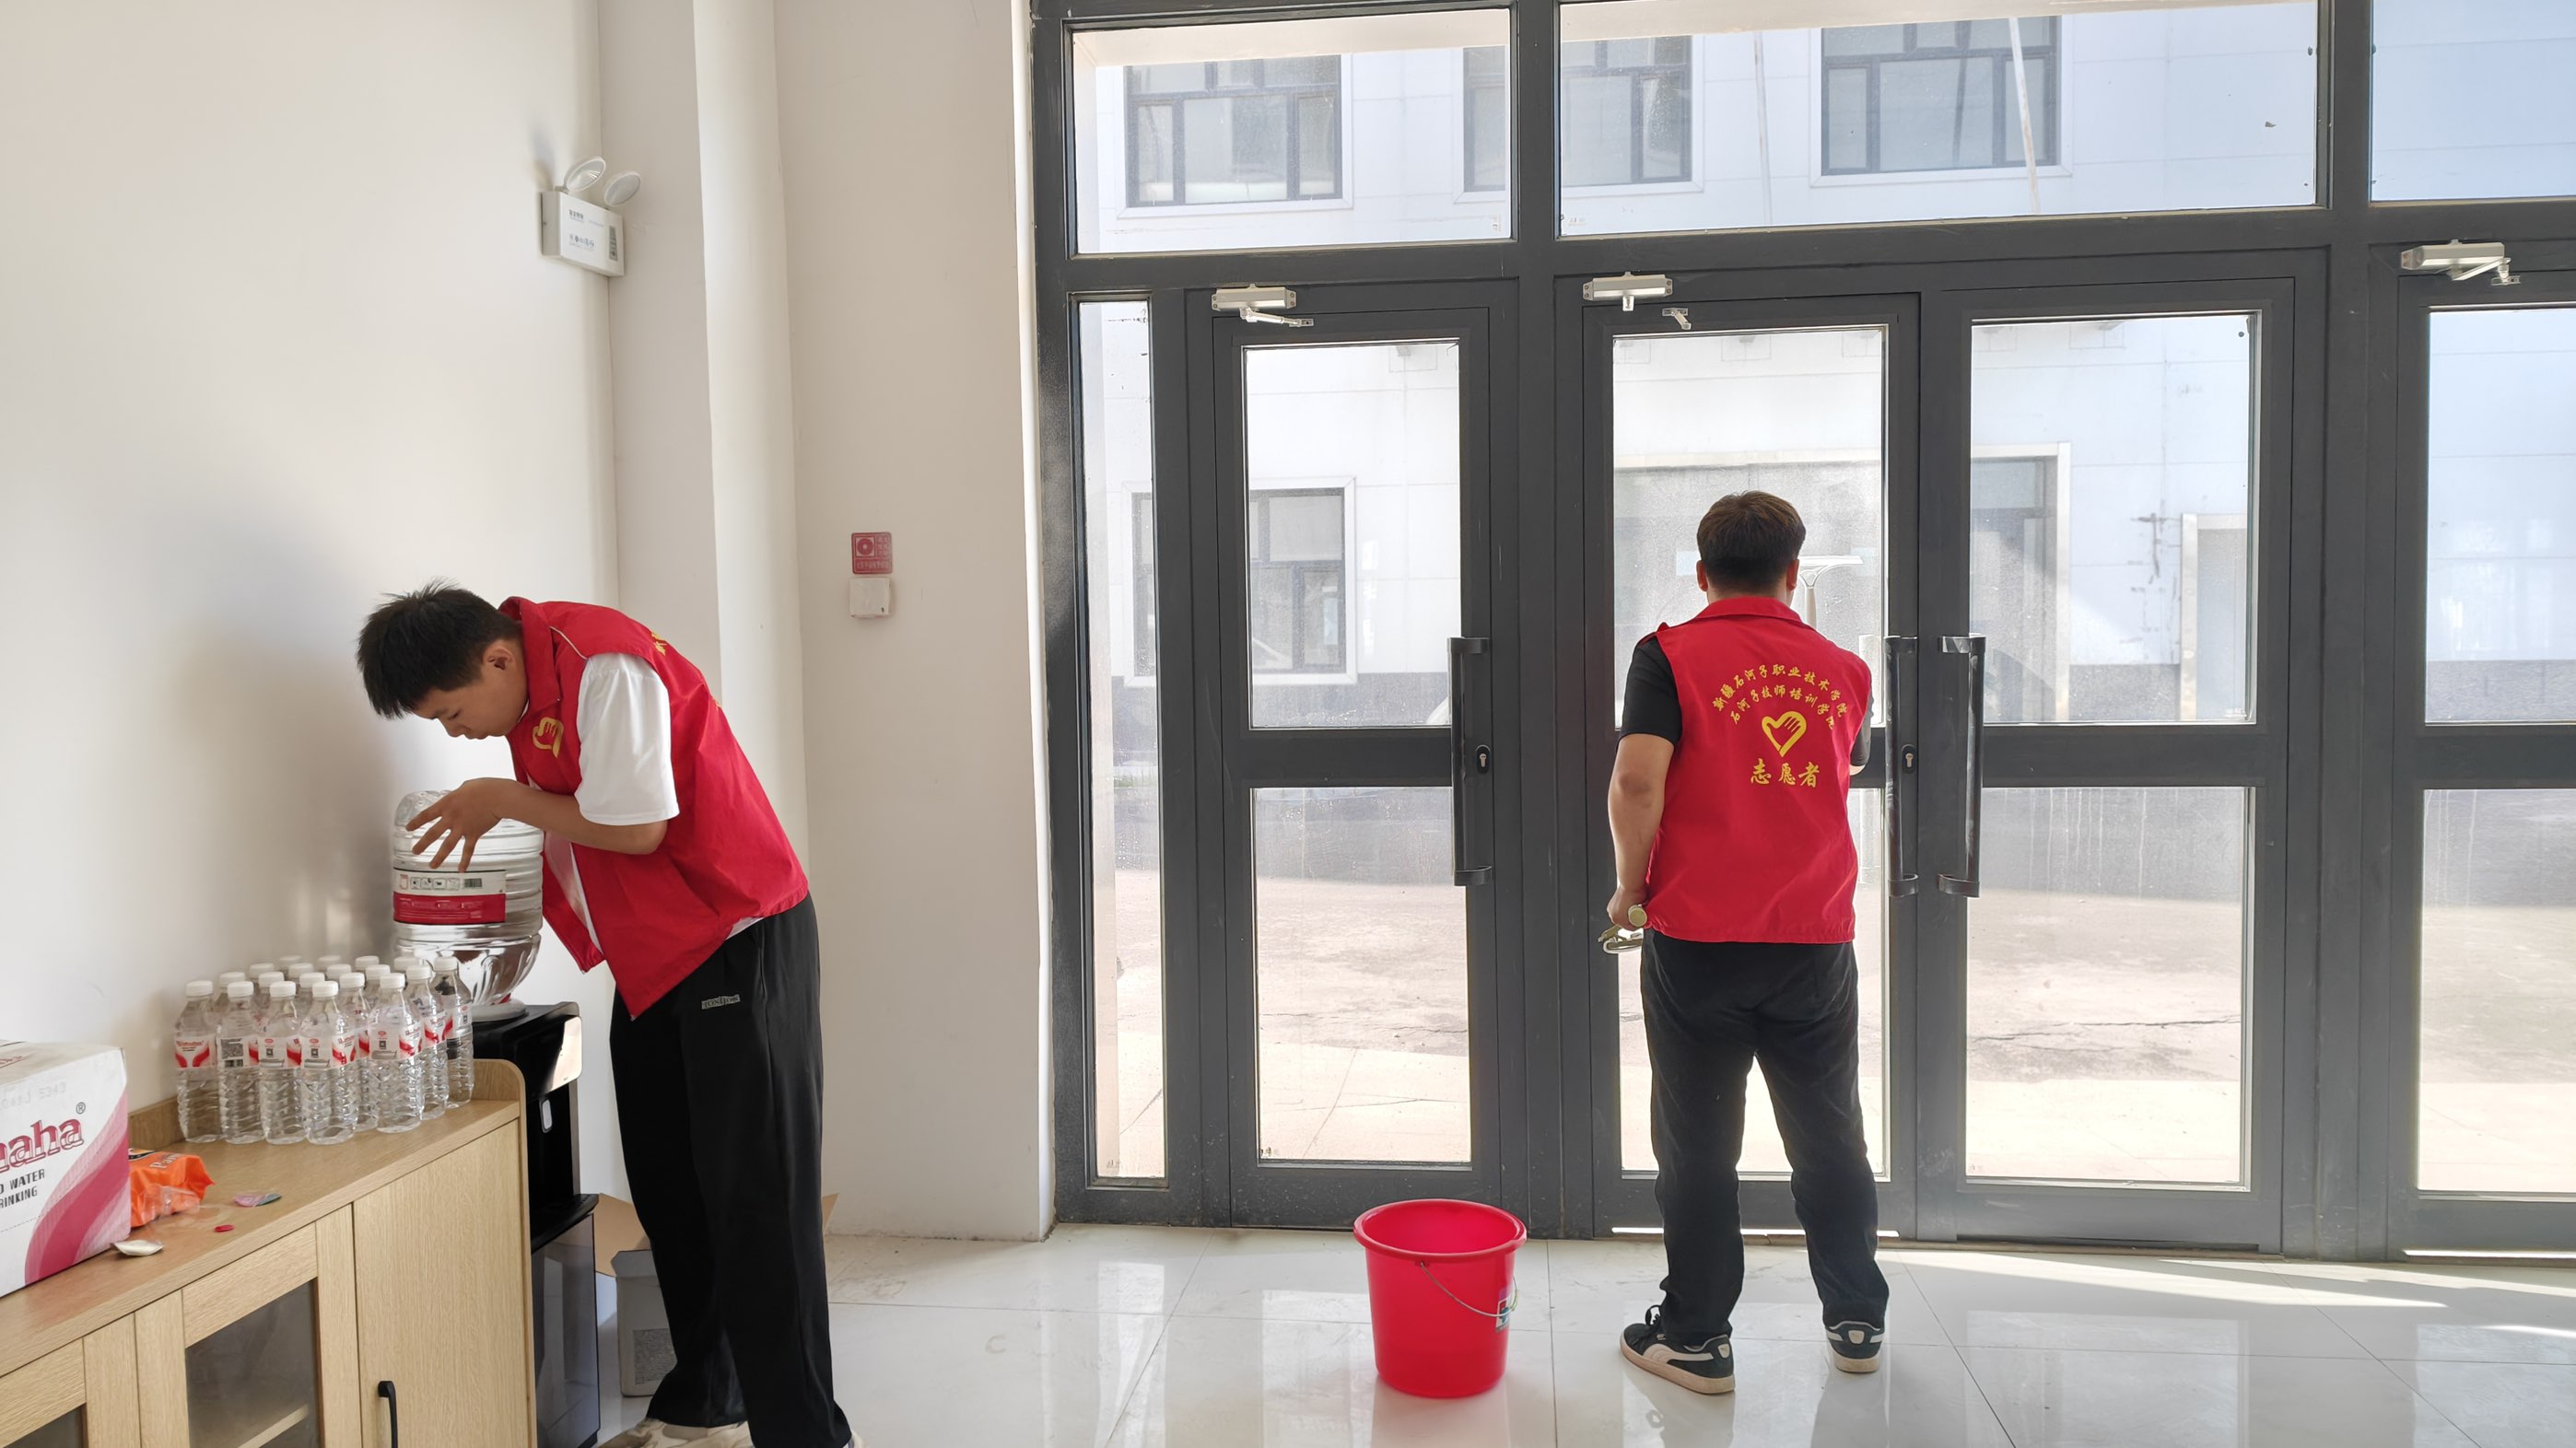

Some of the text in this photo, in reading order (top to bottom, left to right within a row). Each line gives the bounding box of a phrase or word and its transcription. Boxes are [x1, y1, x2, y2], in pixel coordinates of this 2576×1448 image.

[1751, 757, 1821, 788] 志愿者
[9, 1168, 45, 1190] WATER
